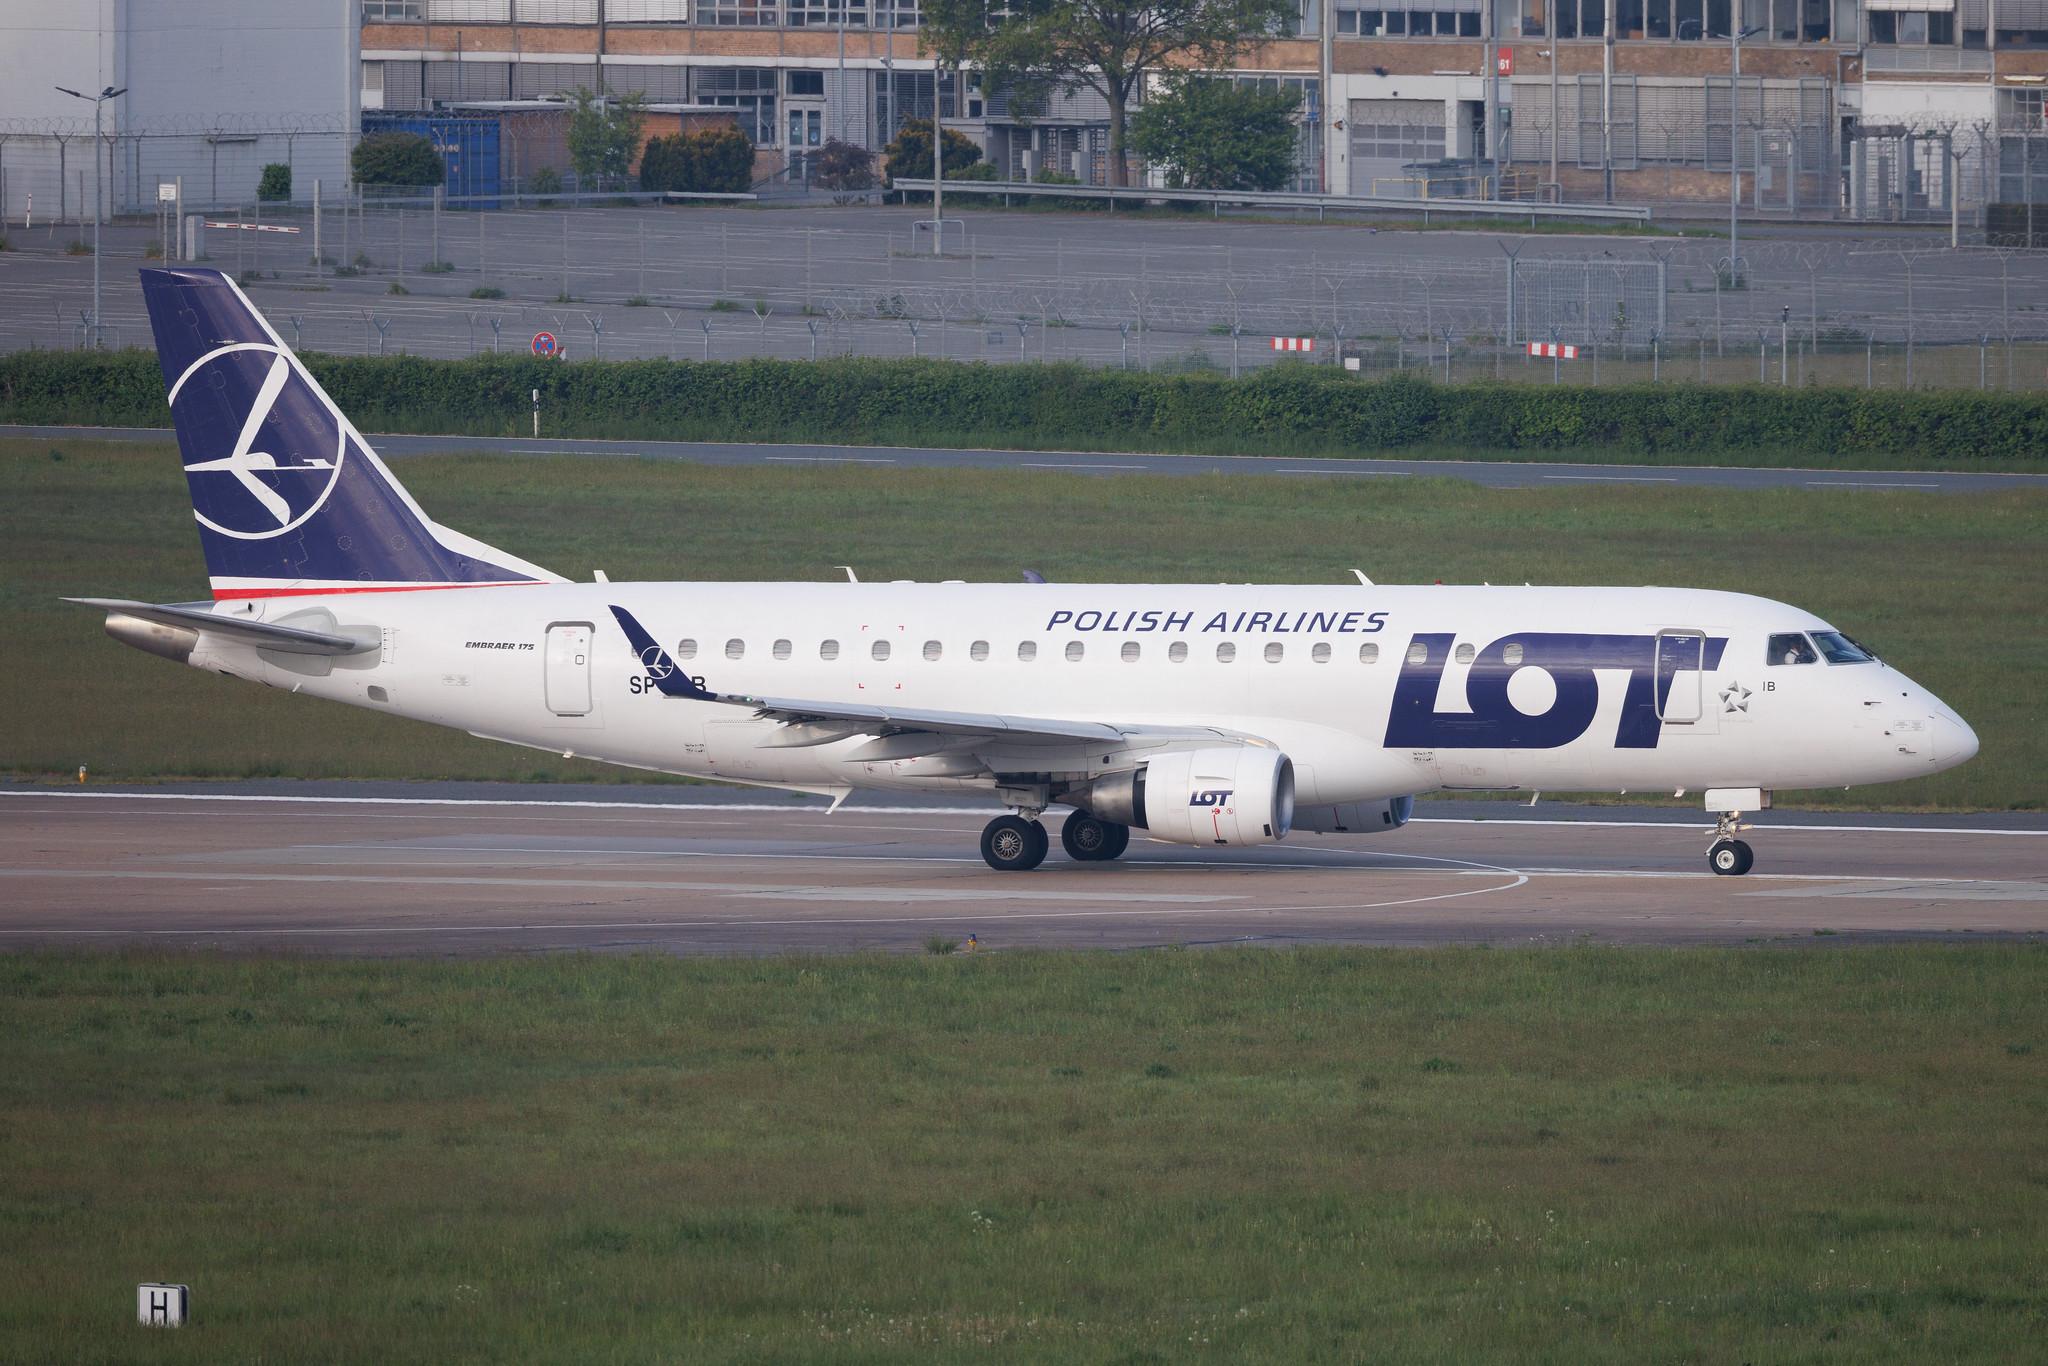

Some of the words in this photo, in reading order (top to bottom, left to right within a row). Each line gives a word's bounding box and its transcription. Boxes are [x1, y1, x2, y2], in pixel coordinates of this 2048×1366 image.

[1045, 610, 1195, 632] POLISH
[1201, 611, 1390, 633] AIRLINES
[464, 641, 516, 650] EMBRAER
[518, 643, 535, 651] 175
[1382, 632, 1730, 749] LOT
[1189, 790, 1234, 807] LOT
[150, 1290, 168, 1325] H
